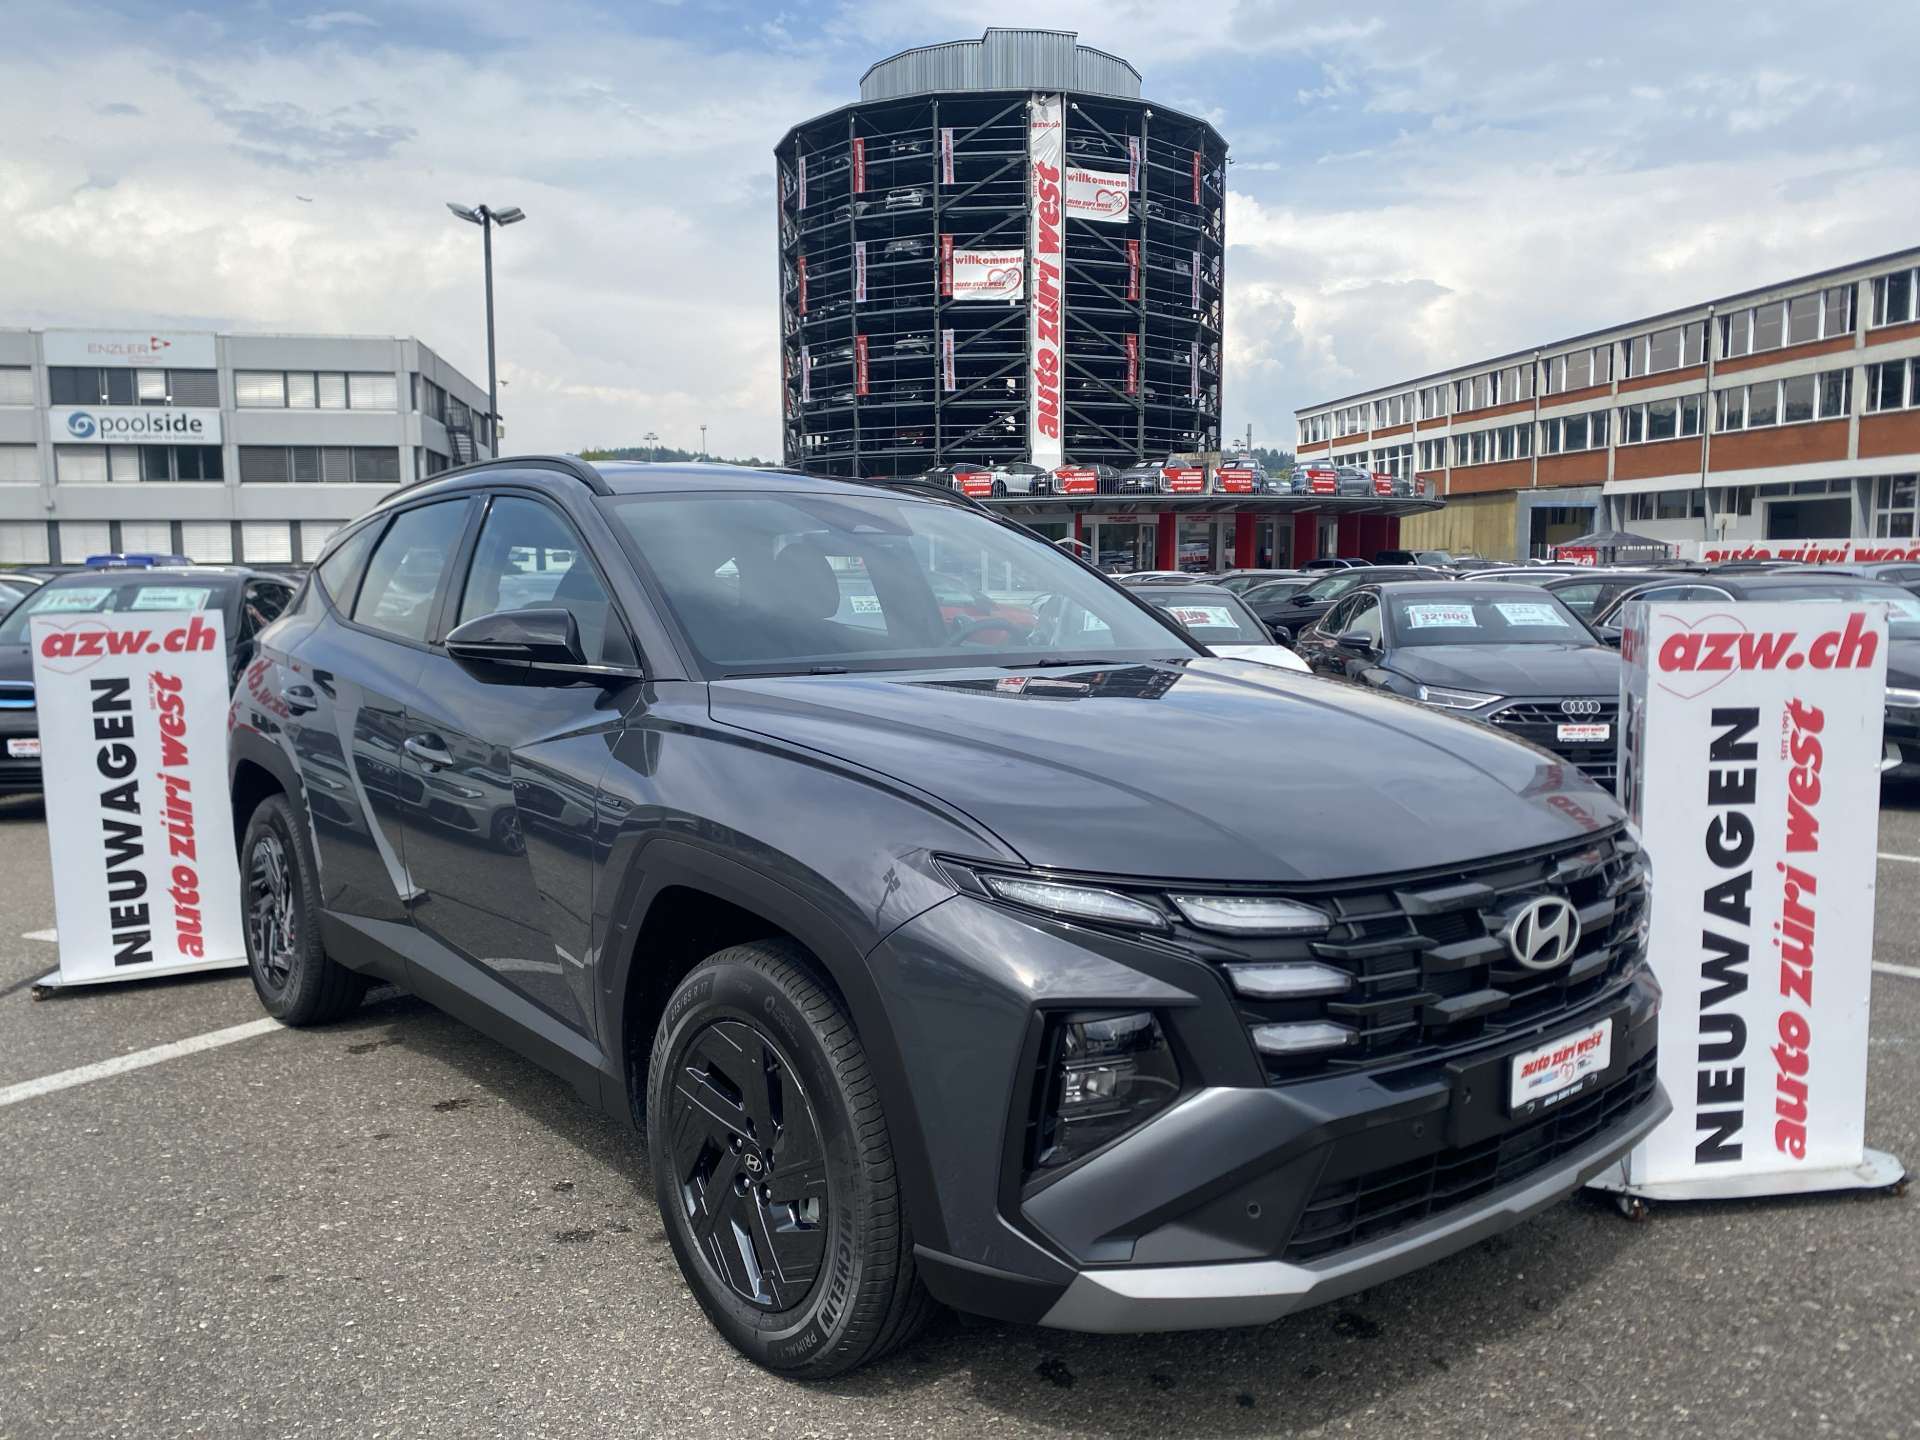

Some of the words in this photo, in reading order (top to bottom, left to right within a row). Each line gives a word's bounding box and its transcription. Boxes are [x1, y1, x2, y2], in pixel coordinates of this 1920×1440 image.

[1032, 120, 1060, 128] azw.ch
[1034, 160, 1060, 254] west
[1066, 173, 1128, 188] willkommen
[954, 255, 1023, 265] willkommen
[1033, 257, 1060, 346] züri
[100, 413, 203, 440] poolside
[1034, 348, 1060, 440] auto
[41, 617, 217, 658] azw.ch
[1657, 613, 1879, 673] azw.ch
[149, 671, 190, 767] west
[157, 773, 197, 862] züri
[1784, 697, 1825, 852] west
[90, 678, 153, 966] NEUWAGEN
[168, 864, 204, 958] auto
[1695, 707, 1760, 1164] NEUWAGEN
[1773, 861, 1817, 1007] züri
[1521, 1055, 1552, 1078] auto
[1551, 1043, 1578, 1066] züri
[1577, 1030, 1604, 1055] west
[1770, 1011, 1811, 1161] auto
[821, 1203, 852, 1330] MICHELIN
